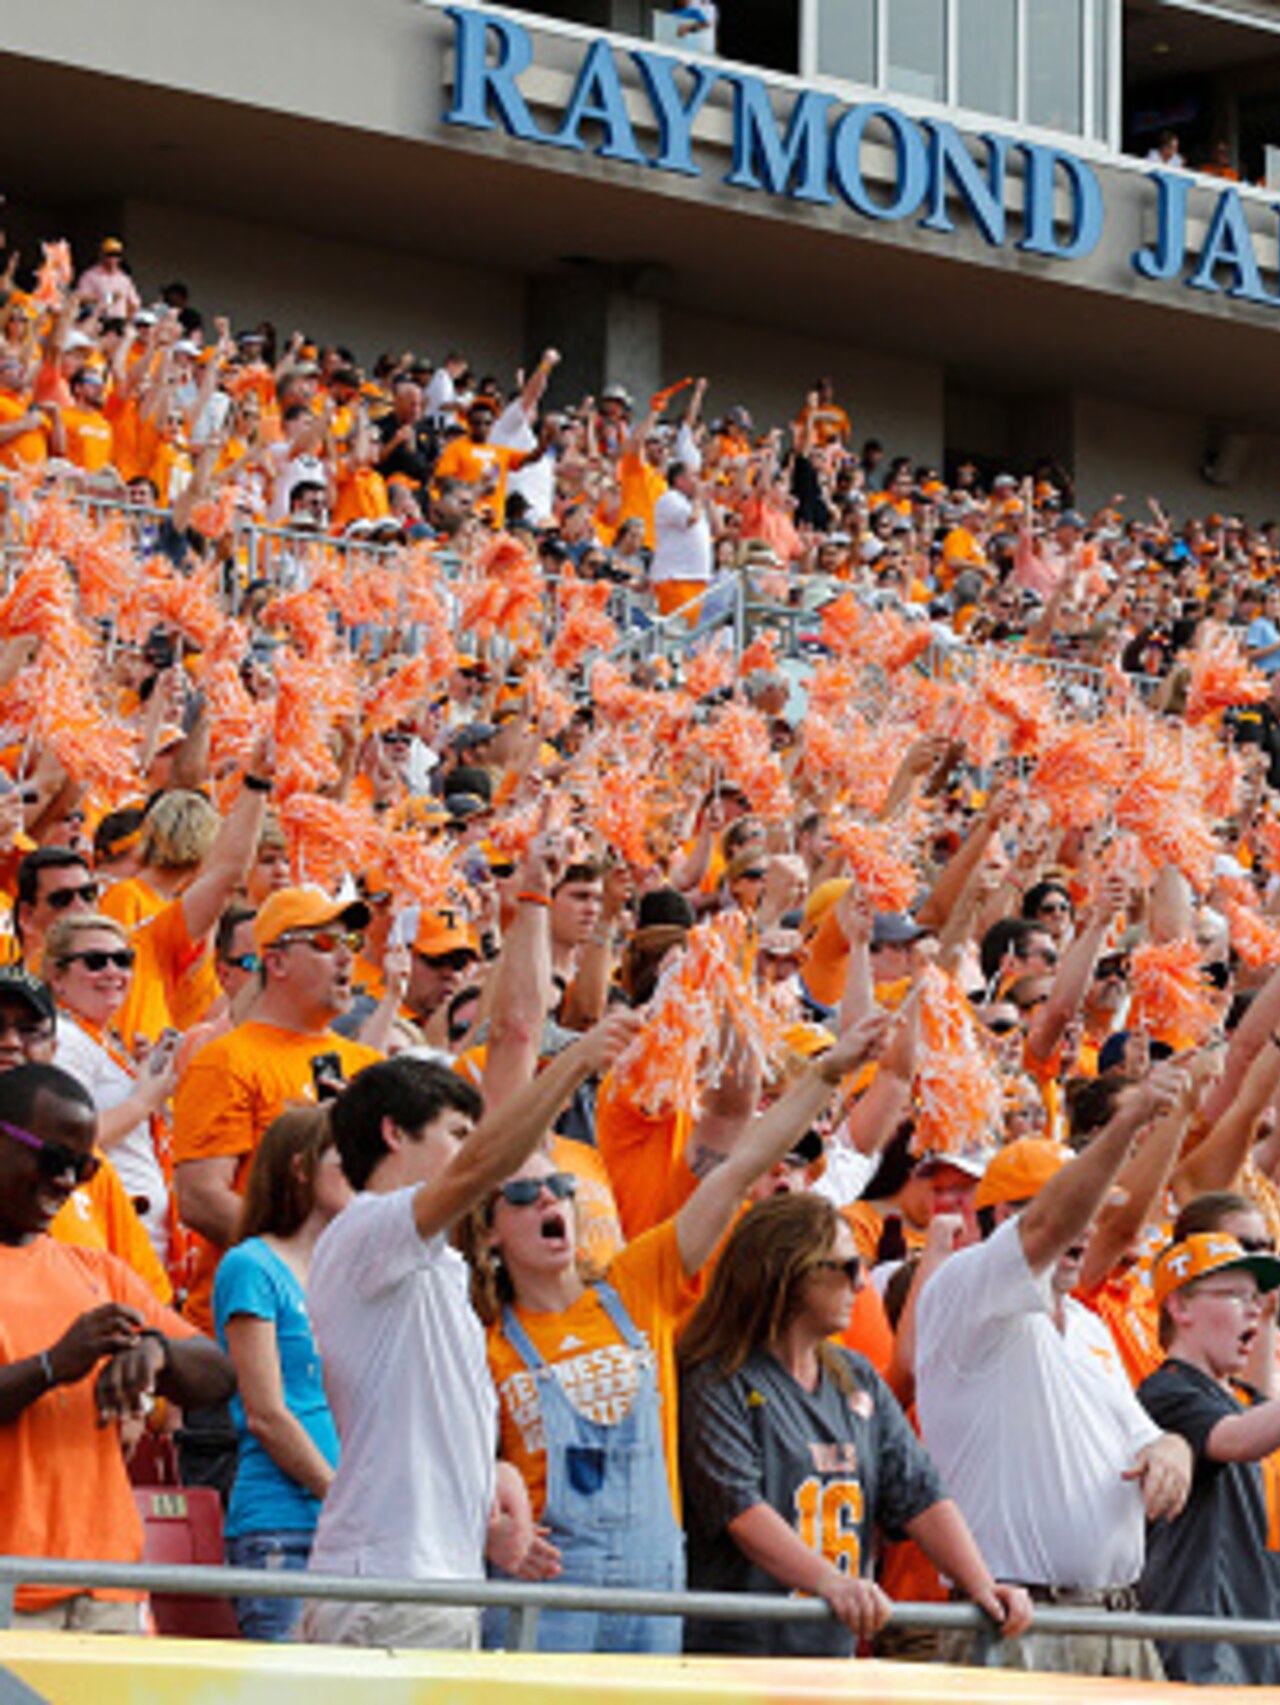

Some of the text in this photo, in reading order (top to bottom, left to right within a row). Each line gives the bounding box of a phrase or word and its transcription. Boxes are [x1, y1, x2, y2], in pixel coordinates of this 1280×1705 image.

[442, 5, 1104, 261] RAYMOND
[1167, 1254, 1193, 1278] T
[792, 1475, 865, 1594] 16
